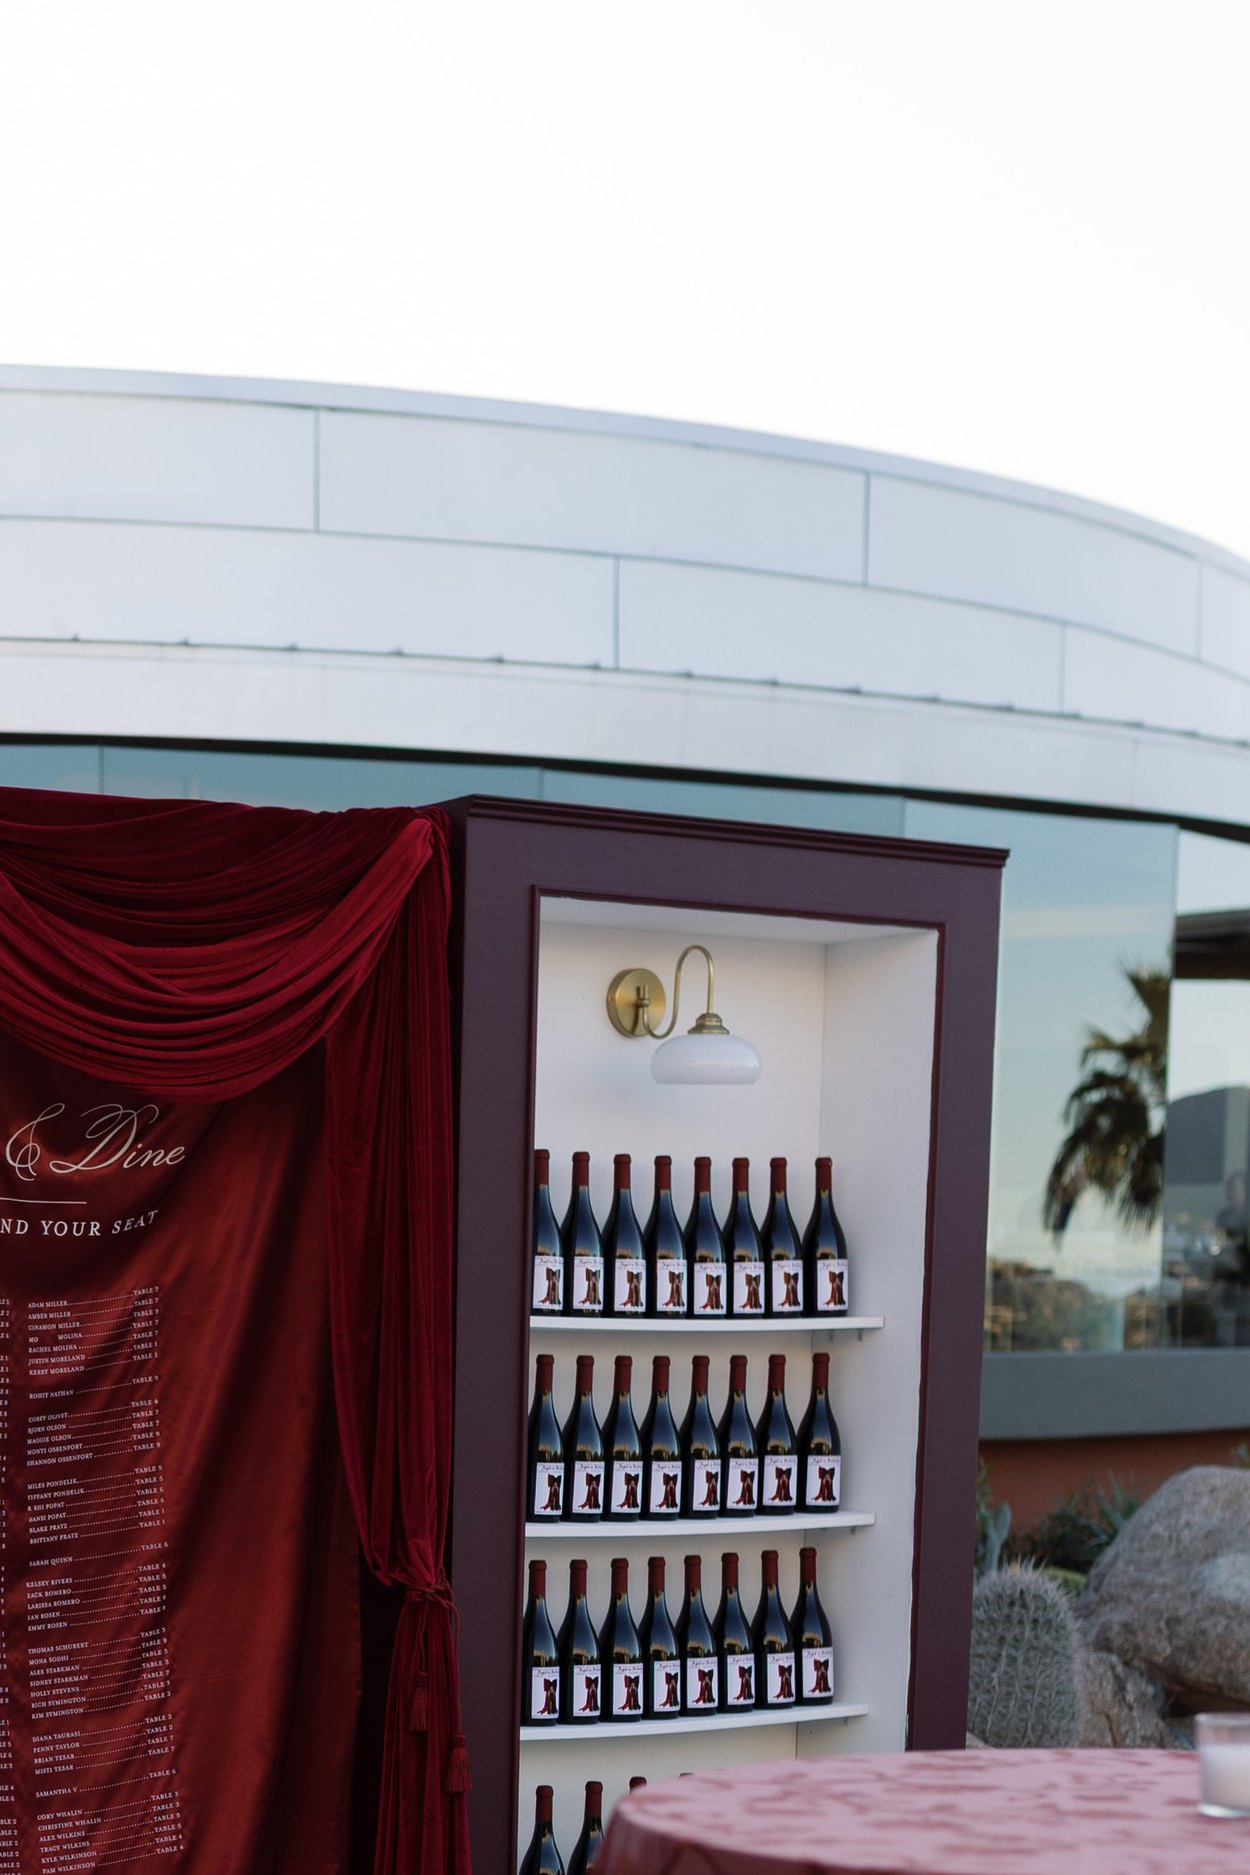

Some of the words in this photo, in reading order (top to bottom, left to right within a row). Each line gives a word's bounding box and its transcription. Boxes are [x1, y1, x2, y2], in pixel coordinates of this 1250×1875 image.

[5, 1102, 65, 1181] &
[49, 1103, 186, 1174] Dine
[40, 1220, 102, 1237] YOUR
[111, 1209, 159, 1234] SEAT
[133, 1288, 153, 1296] TABLE
[50, 1366, 84, 1374] MORELAND
[51, 1434, 72, 1442] OLSON
[27, 1458, 56, 1466] SHANNON
[58, 1453, 93, 1463] OSSENFORT
[133, 1443, 154, 1451] TABLE
[47, 1478, 77, 1488] PONDELIK
[53, 1488, 84, 1497] PONDELIK
[141, 1543, 162, 1551] TABLE
[45, 1589, 71, 1597] ROMERO
[139, 1575, 160, 1583] TABLE
[28, 1602, 52, 1610] LARISSA
[53, 1599, 80, 1607] ROMERO
[56, 1642, 89, 1651] SCHUBERT
[141, 1629, 160, 1638] TABLE
[142, 1640, 161, 1648] TABLE
[30, 1690, 50, 1698] HOLLY
[52, 1687, 79, 1695] STEVENS
[48, 1697, 86, 1706] SYMINGTON
[143, 1682, 165, 1690] TABLE
[46, 1708, 84, 1718] SYMINGTON
[144, 1693, 165, 1701] TABLE
[32, 1735, 52, 1743] DIANA
[145, 1716, 166, 1724] TABLE
[37, 1813, 55, 1821] CORY
[57, 1810, 83, 1818] WHALIN
[151, 1793, 172, 1801] TABLE
[38, 1823, 73, 1832] CHRISTINE
[74, 1818, 101, 1827] WHALIN
[152, 1804, 174, 1812] TABLE
[57, 1831, 85, 1840] WILKINS
[153, 1814, 174, 1822] TABLE
[58, 1862, 95, 1872] WILKINSON
[157, 1846, 178, 1854] TABLE
[59, 1851, 97, 1861] WILKINSON
[155, 1835, 177, 1843] TABLE
